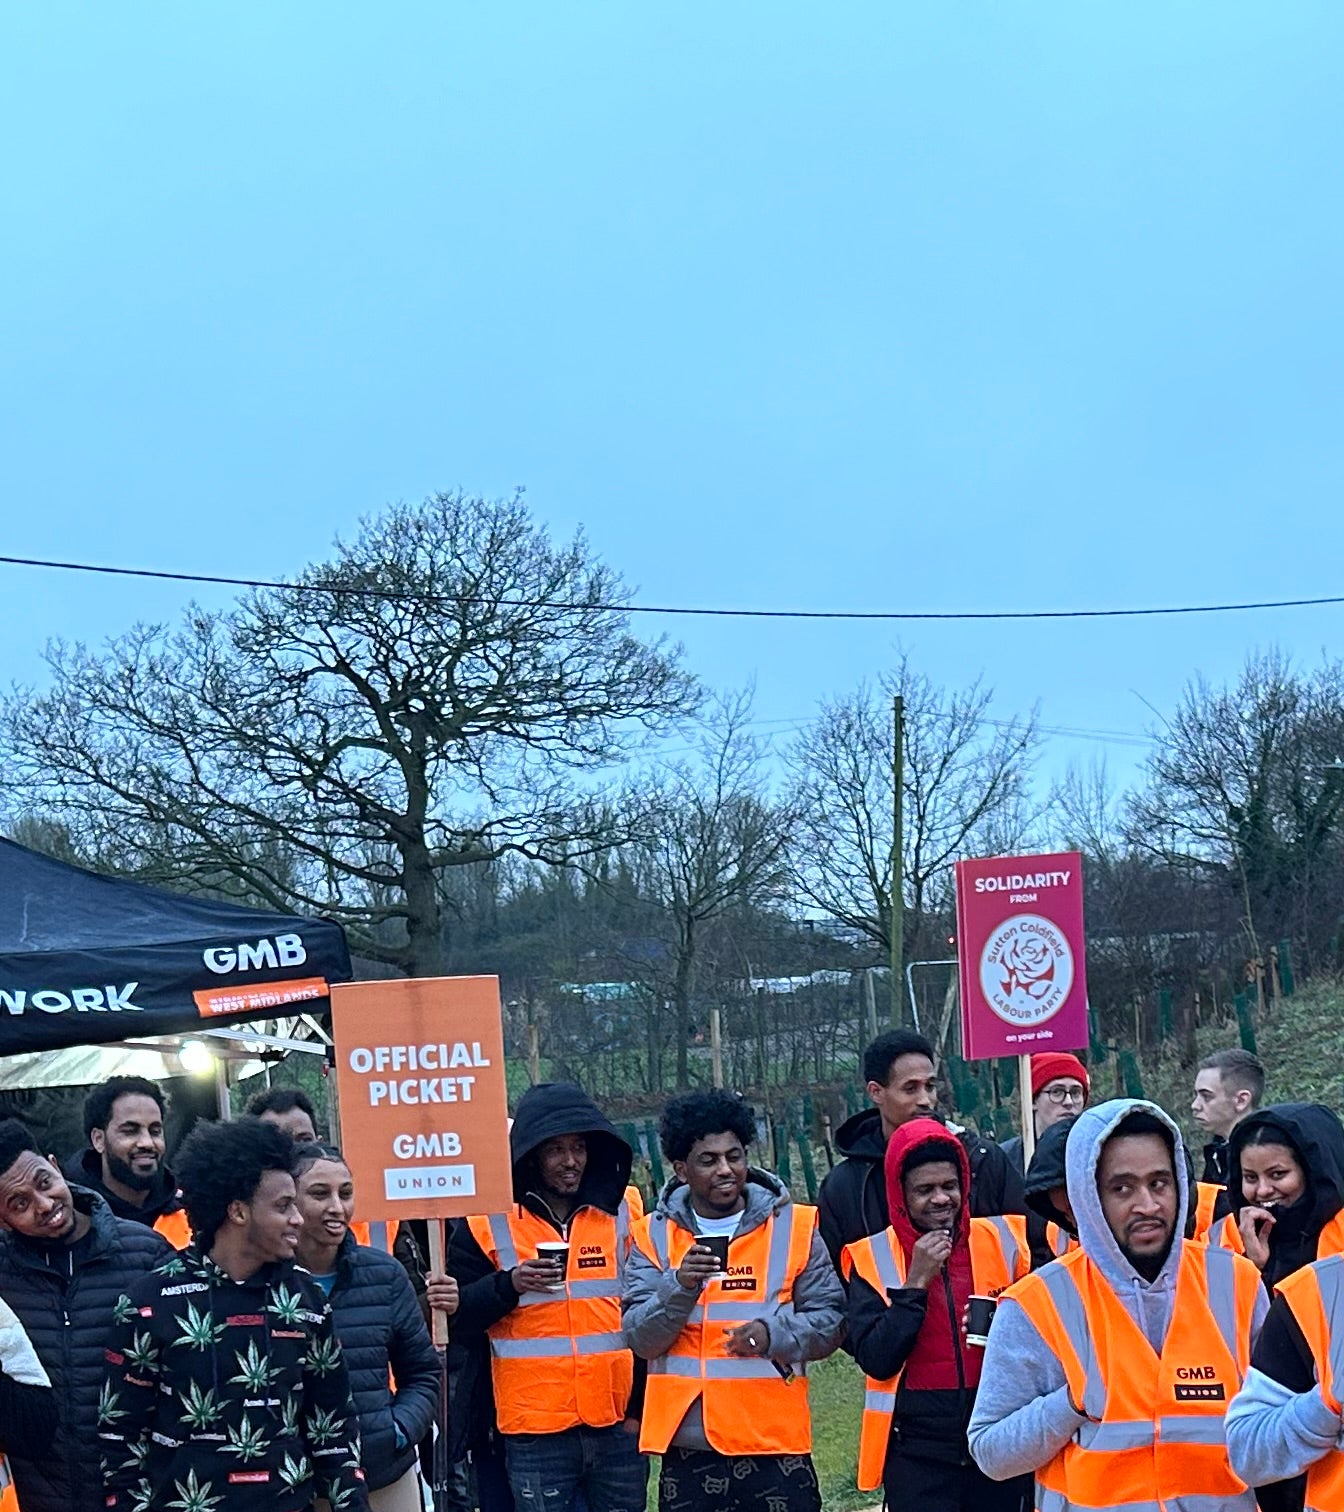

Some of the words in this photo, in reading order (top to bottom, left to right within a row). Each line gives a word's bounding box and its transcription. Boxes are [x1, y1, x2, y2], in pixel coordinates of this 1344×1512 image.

[975, 871, 1070, 893] SOLIDARITY
[1010, 893, 1038, 904] FROM
[203, 934, 307, 974] GMB
[987, 926, 1018, 964] Sutton
[1020, 922, 1065, 958] Coldfield
[249, 988, 320, 1008] MIDLANDS
[992, 993, 1032, 1019] LABOUR
[1035, 987, 1064, 1017] PARTY
[1006, 1034, 1017, 1042] on
[1018, 1032, 1036, 1043] your
[1037, 1030, 1054, 1040] side
[349, 1042, 490, 1074] OFFICIAL
[369, 1076, 475, 1107] PICKET
[393, 1133, 462, 1159] GMB
[398, 1176, 462, 1189] UNION
[727, 1266, 753, 1276] GMB
[1176, 1366, 1216, 1379] GMB
